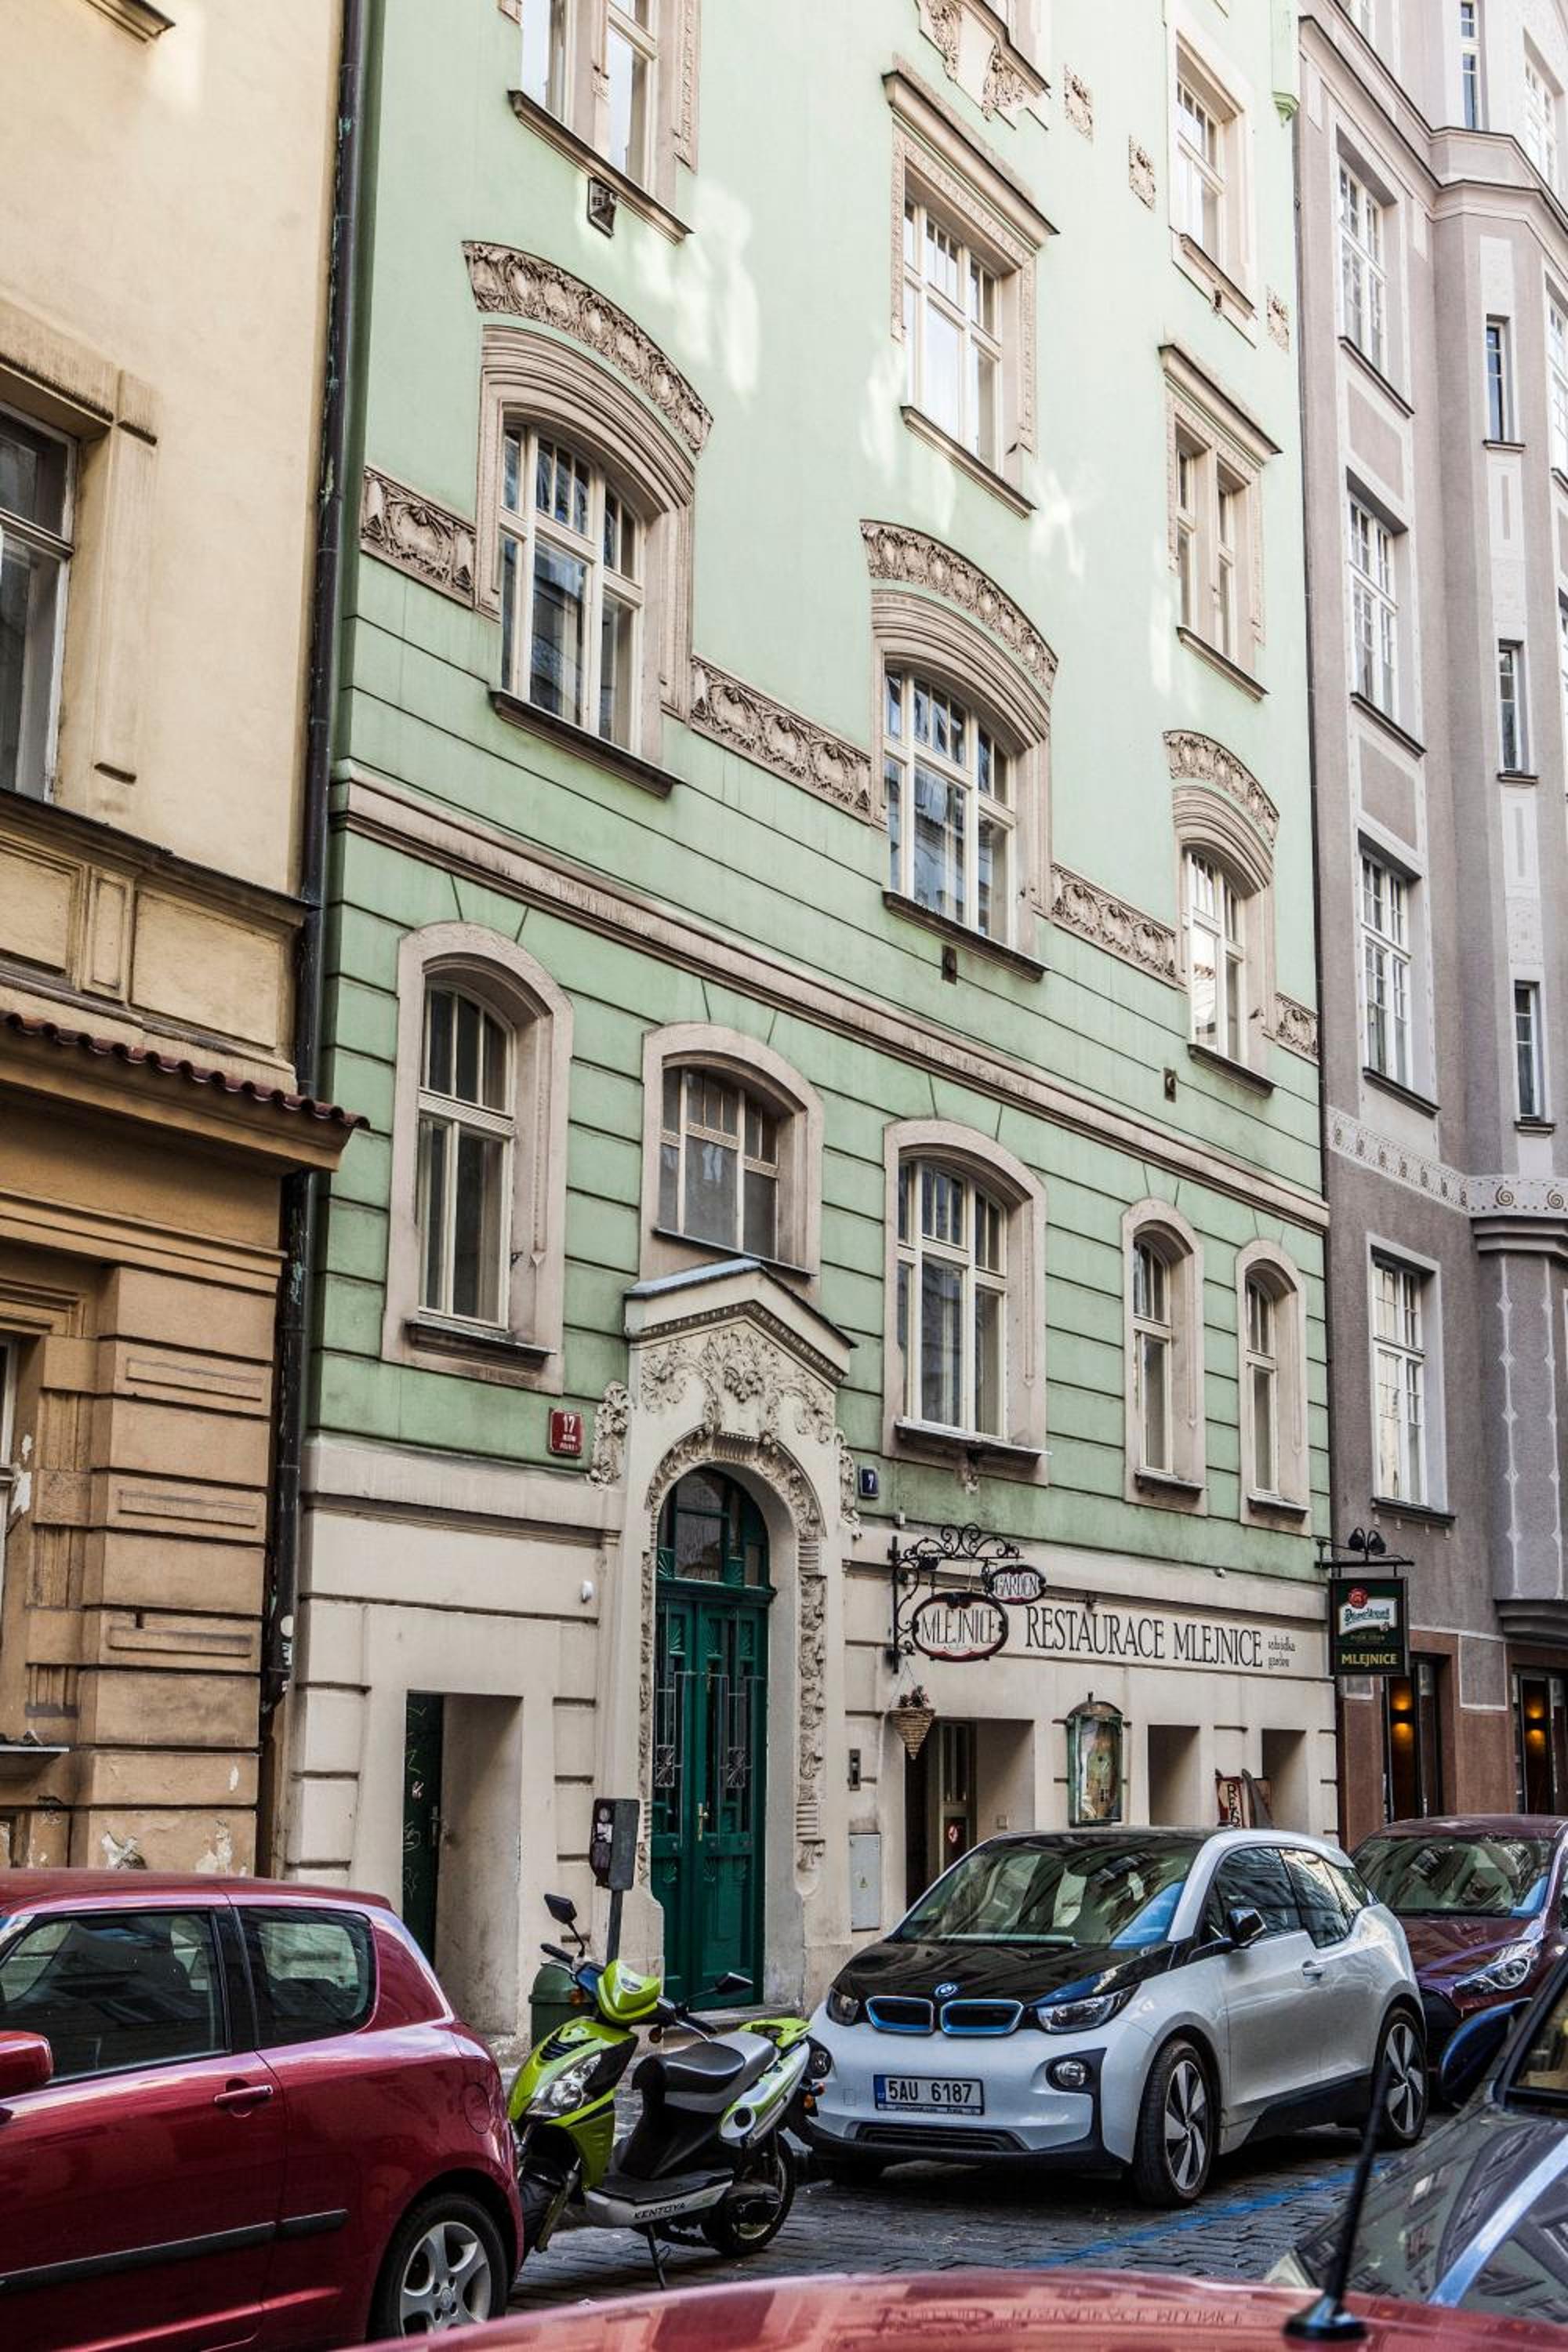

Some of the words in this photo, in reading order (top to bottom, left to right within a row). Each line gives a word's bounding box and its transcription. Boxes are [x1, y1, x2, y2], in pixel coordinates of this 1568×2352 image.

[563, 1414, 575, 1434] 17
[920, 1609, 998, 1644] MLEJNICE
[1025, 1606, 1166, 1660] RESTAURACE
[1173, 1622, 1263, 1668] MLEJNICE
[1341, 1653, 1398, 1667] MLEJNICE
[888, 2080, 919, 2101] 5AU
[931, 2082, 973, 2103] 6187
